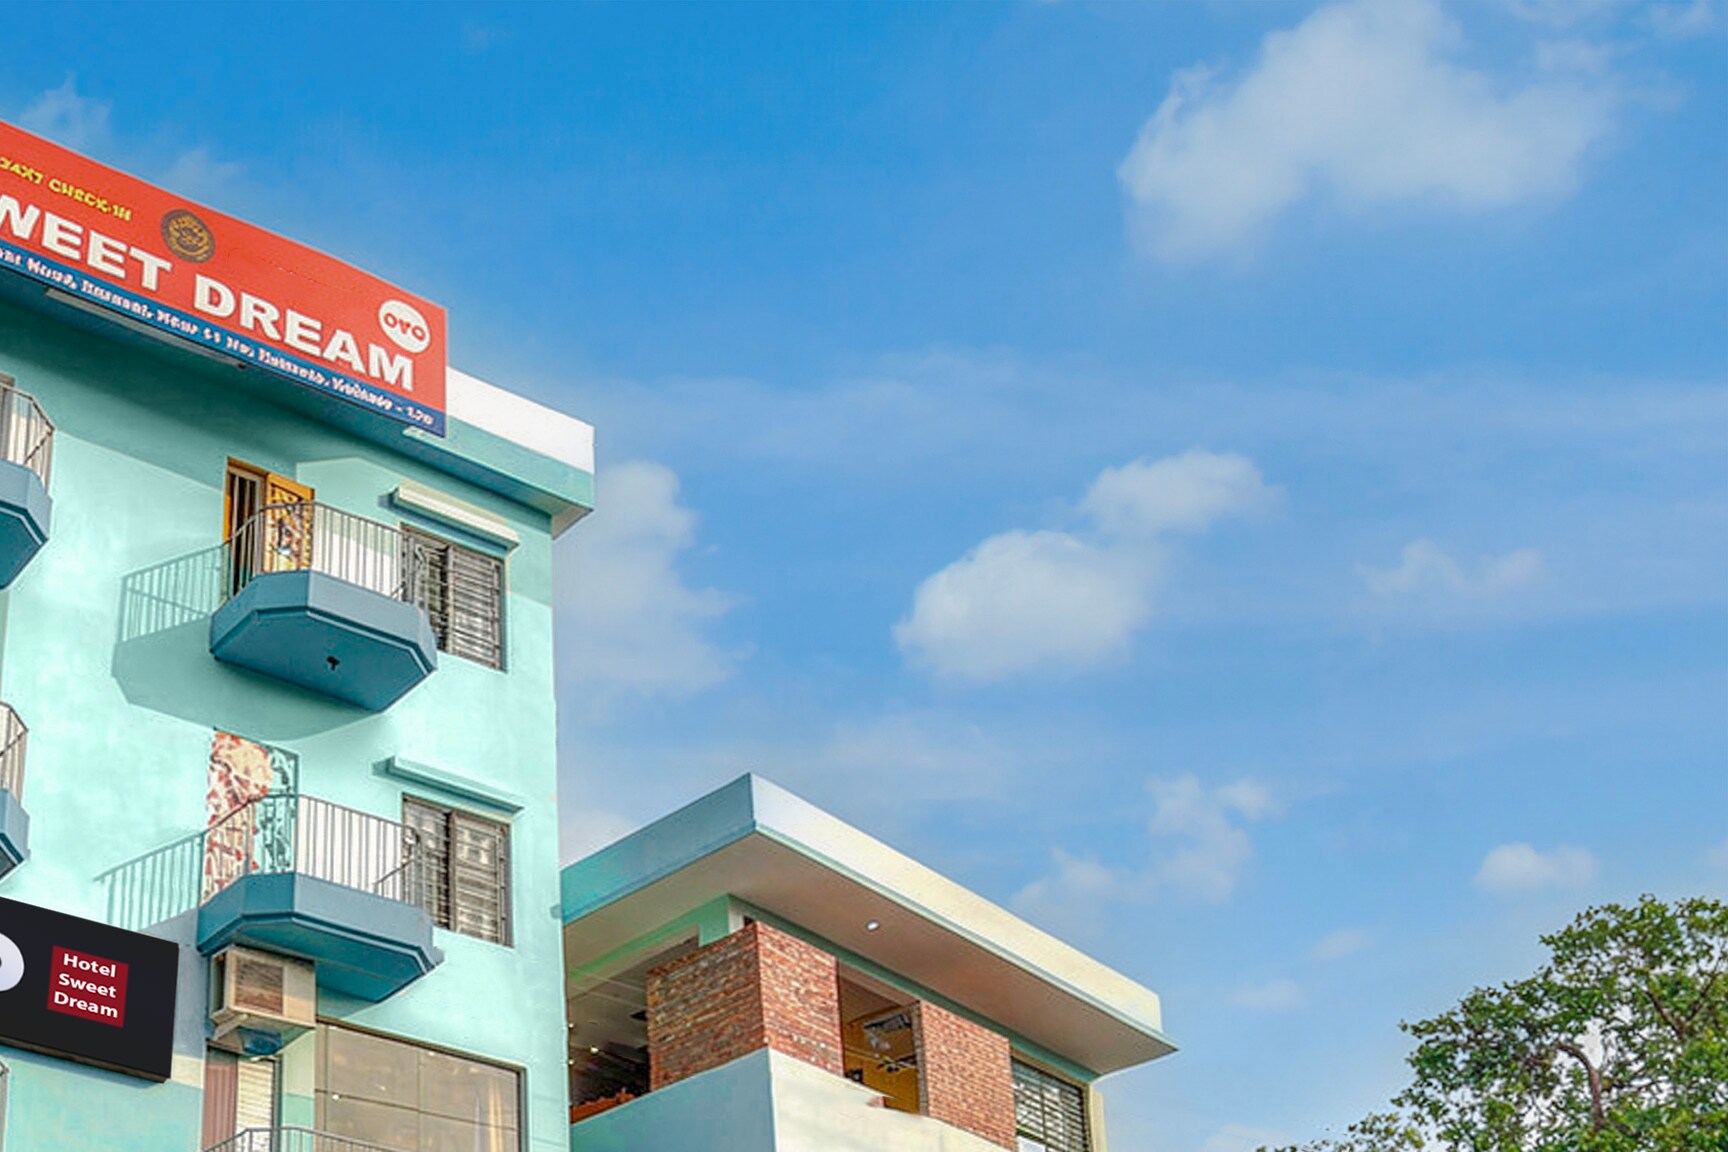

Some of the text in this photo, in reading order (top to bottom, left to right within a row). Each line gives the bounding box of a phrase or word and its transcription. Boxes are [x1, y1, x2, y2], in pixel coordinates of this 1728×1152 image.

[193, 273, 414, 392] DREAM
[62, 952, 116, 978] Hotel
[58, 972, 117, 999] Sweet
[53, 990, 119, 1019] Dream
